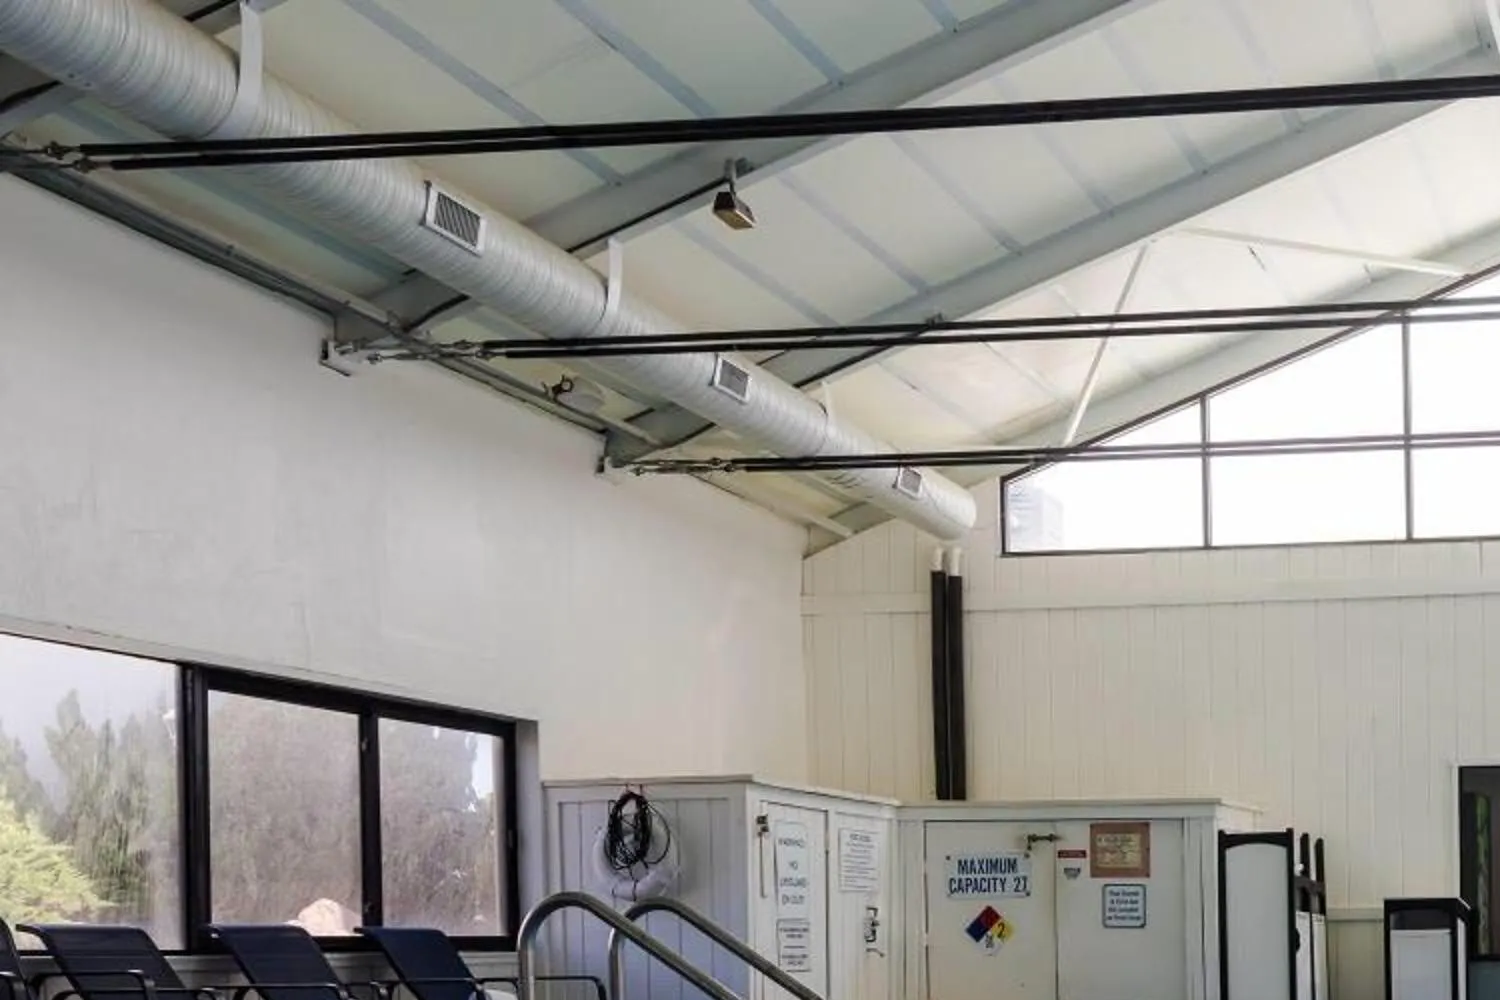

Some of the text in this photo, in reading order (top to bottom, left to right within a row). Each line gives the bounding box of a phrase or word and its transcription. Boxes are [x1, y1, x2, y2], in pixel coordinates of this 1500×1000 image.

[957, 857, 1018, 875] MAXIMUM
[948, 875, 1029, 895] CAPACITY 27
